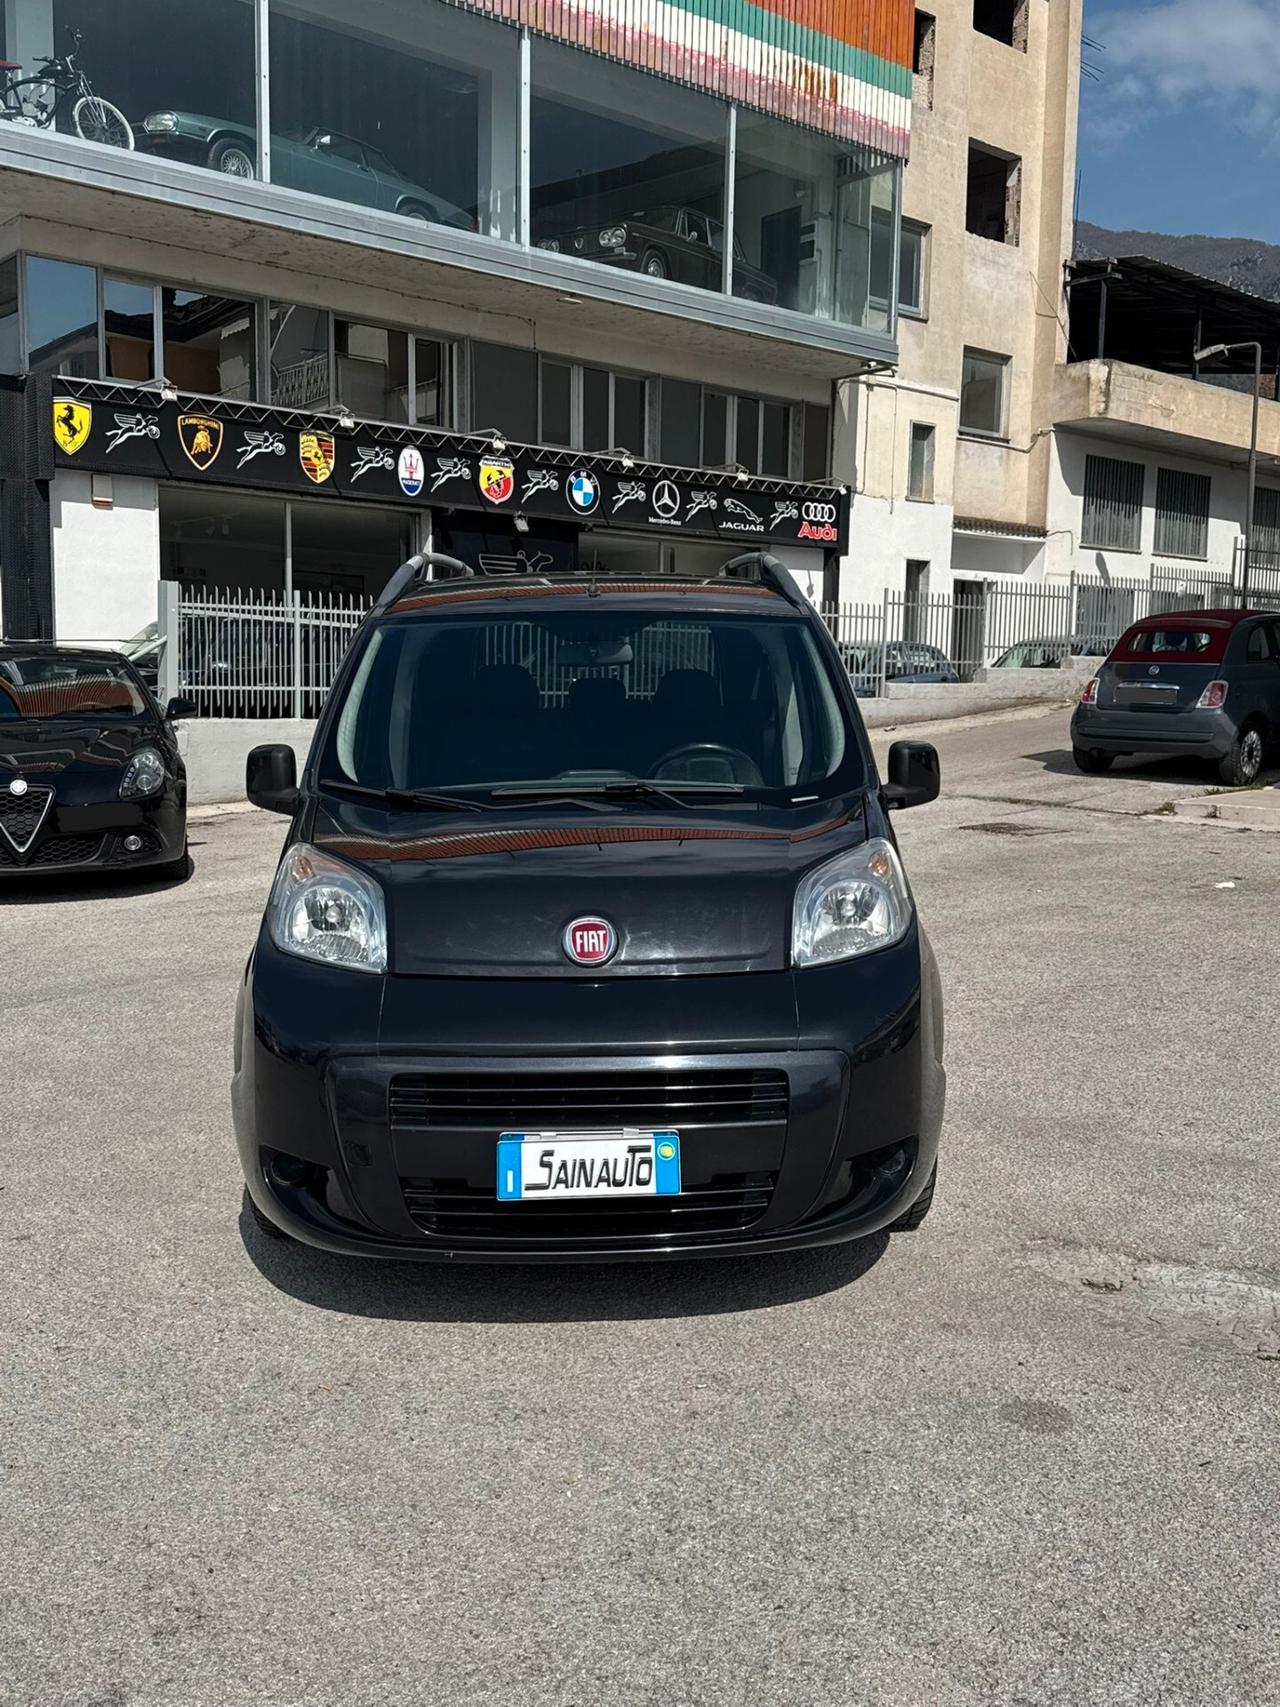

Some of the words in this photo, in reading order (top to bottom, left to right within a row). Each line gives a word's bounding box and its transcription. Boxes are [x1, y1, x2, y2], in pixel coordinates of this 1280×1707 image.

[718, 521, 765, 532] JAGUAR
[797, 521, 838, 541] Audi
[575, 929, 606, 953] FIAT
